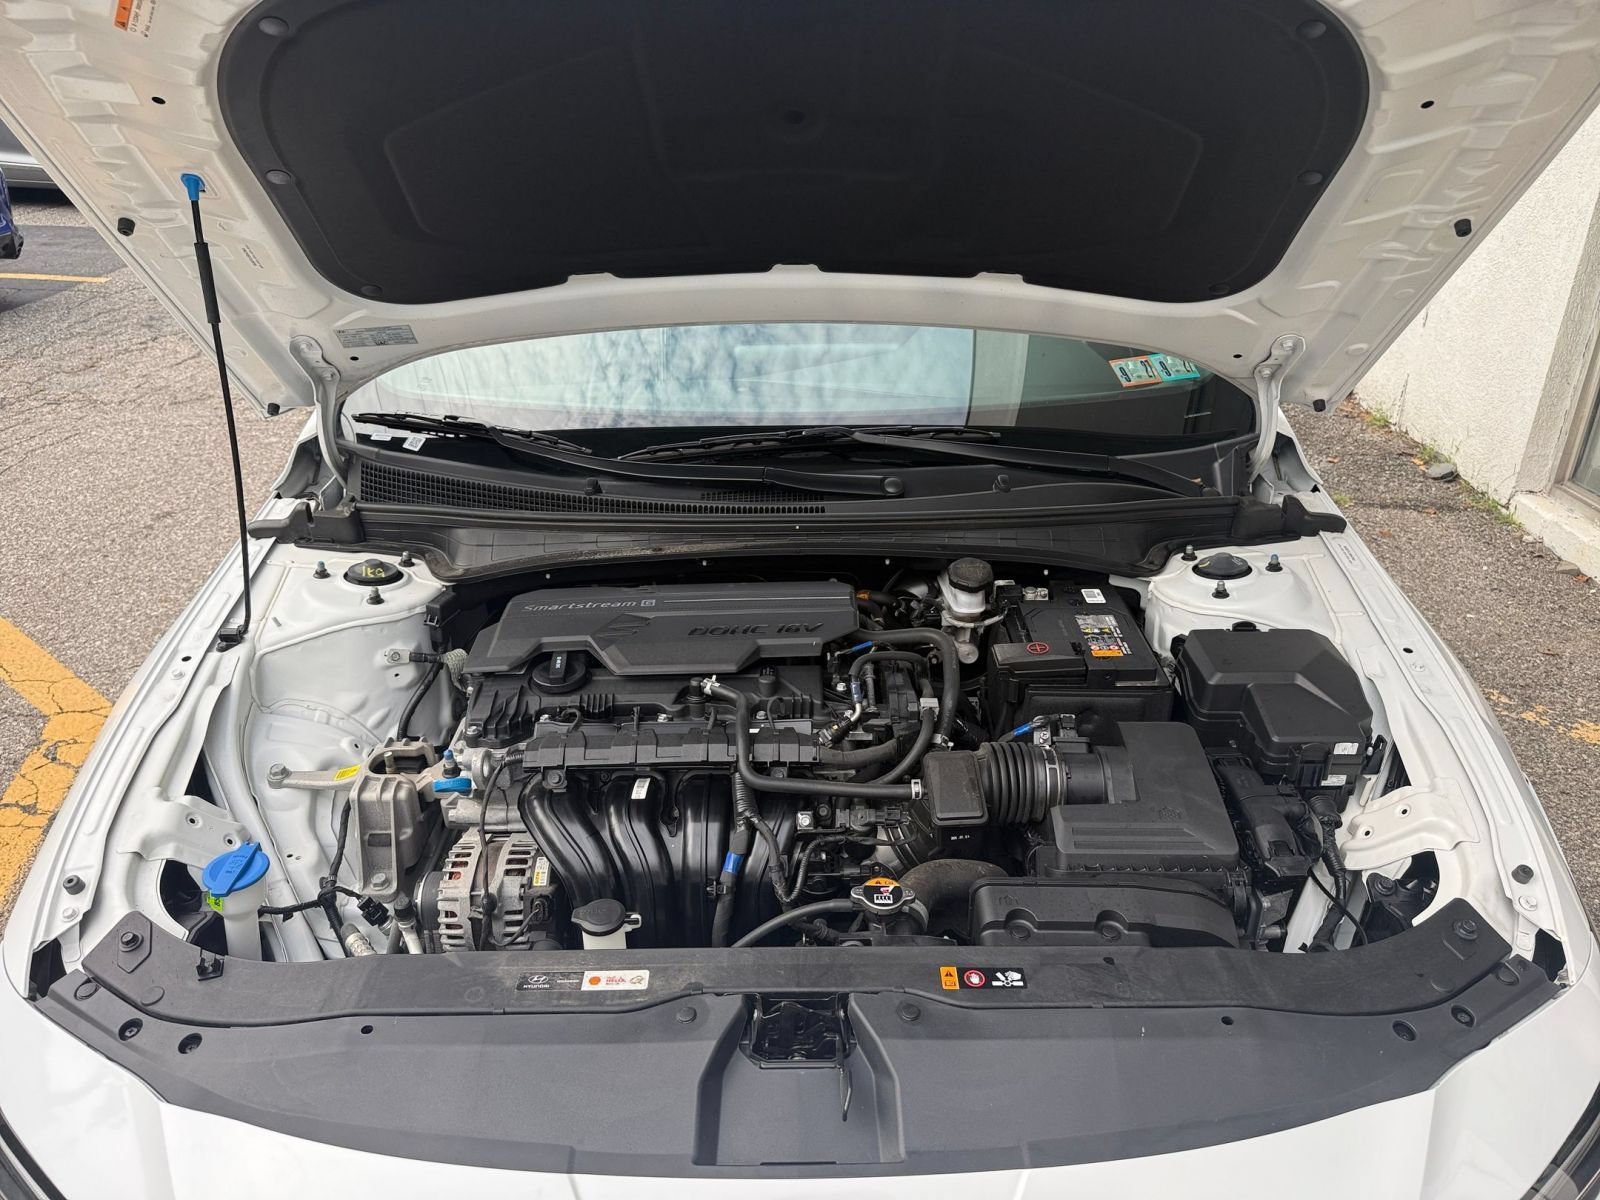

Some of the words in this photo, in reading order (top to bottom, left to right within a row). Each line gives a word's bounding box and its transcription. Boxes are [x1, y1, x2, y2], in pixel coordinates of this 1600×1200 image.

[521, 600, 637, 612] Smartstream
[688, 624, 769, 636] DOHC
[776, 623, 824, 634] 16V
